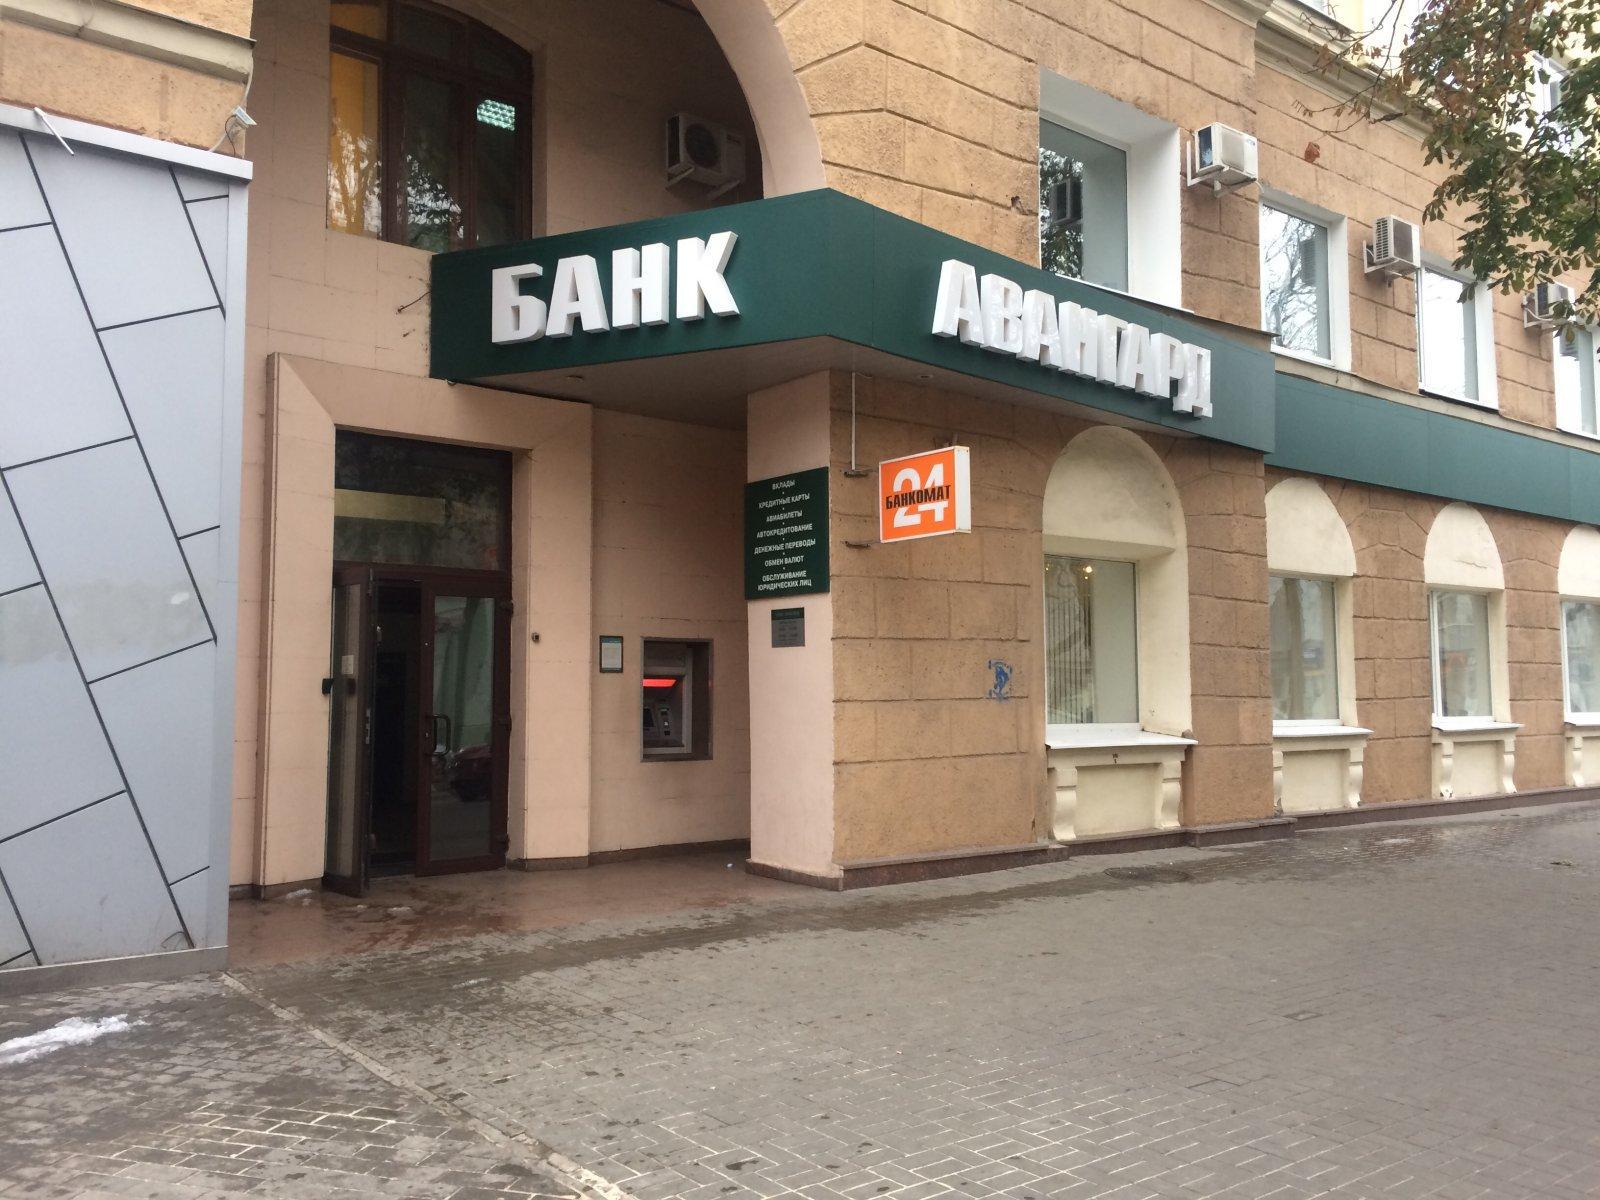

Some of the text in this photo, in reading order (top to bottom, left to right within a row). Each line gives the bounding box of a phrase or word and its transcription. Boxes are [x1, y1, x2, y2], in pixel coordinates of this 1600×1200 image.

[491, 231, 740, 345] БАНК
[932, 259, 1213, 417] АВАНГАРД
[772, 480, 795, 490] ВКЛАДЫ
[759, 493, 810, 508] КРЕДИТНЫЕ КАРТЫ
[886, 485, 951, 509] БАНКОМАТ
[893, 463, 948, 528] 24
[766, 510, 803, 522] АВИАБИЛЕТЫ
[757, 524, 812, 538] АВТОКРЕДИТОВАНИЕ
[754, 539, 816, 555] ДЕНЕЖНЫЕ ПЕРЕВОДЫ
[764, 555, 804, 567] ОБМЕН ВАЛЮТ
[762, 571, 807, 582] ОБСЛУЖИВАНИЕ
[758, 579, 812, 591] ЮРИДИЧЕСКИХ ЛИЦ
